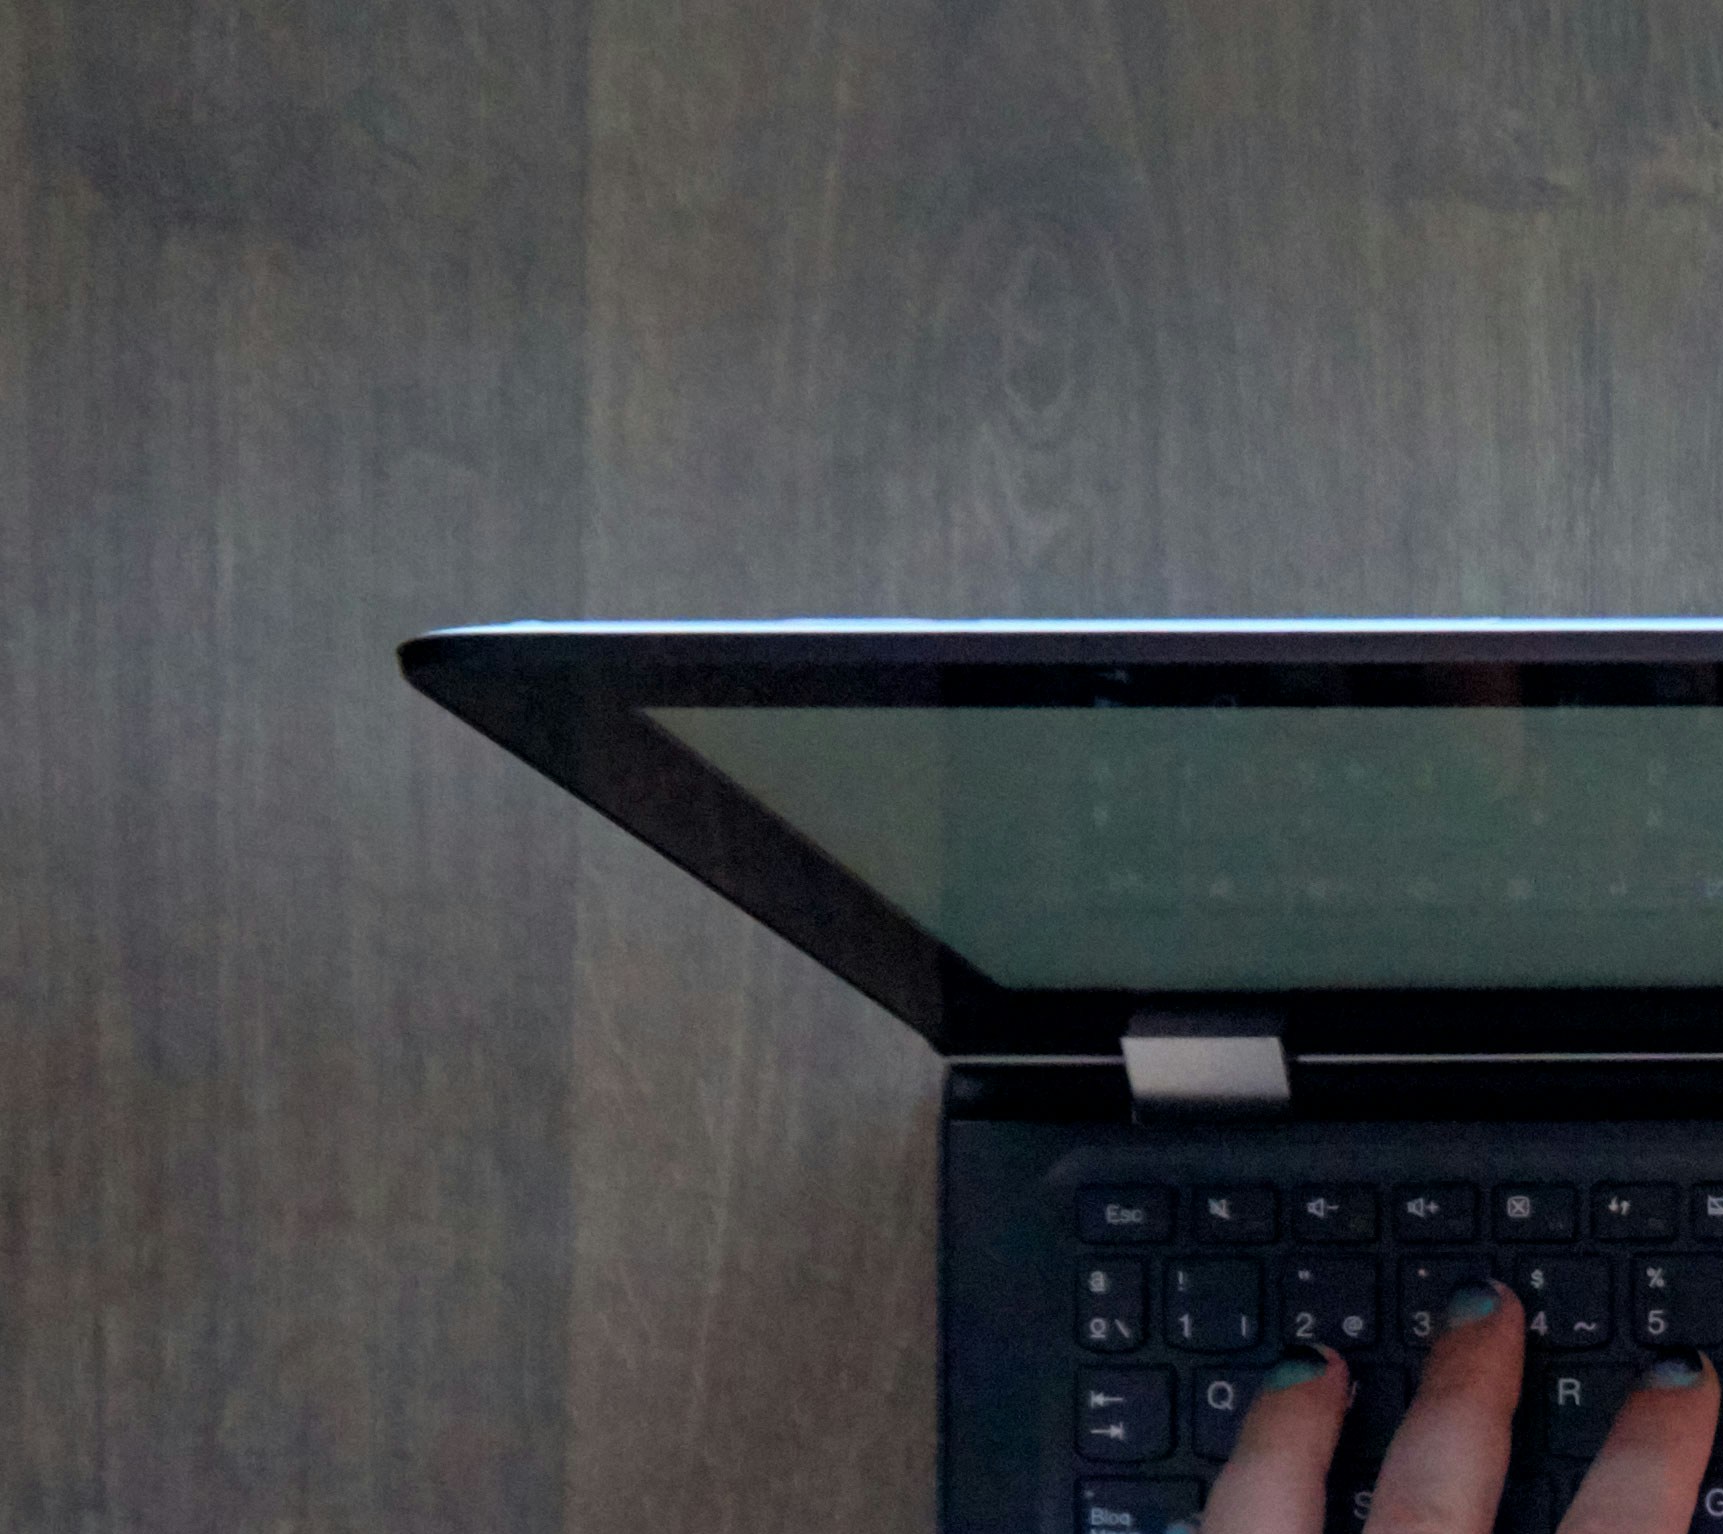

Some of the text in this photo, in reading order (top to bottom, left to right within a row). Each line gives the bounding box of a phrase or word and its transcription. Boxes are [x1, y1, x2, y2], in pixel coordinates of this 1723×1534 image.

[1104, 1203, 1144, 1226] Esc
[1530, 1268, 1545, 1289] $
[1646, 1267, 1666, 1288] %
[1178, 1313, 1192, 1338] 1
[1295, 1311, 1365, 1339] 2 @
[1412, 1310, 1433, 1338] 3
[1529, 1310, 1549, 1336] 4
[1647, 1309, 1667, 1336] 5
[1206, 1380, 1235, 1411] Q
[1557, 1377, 1581, 1406] R
